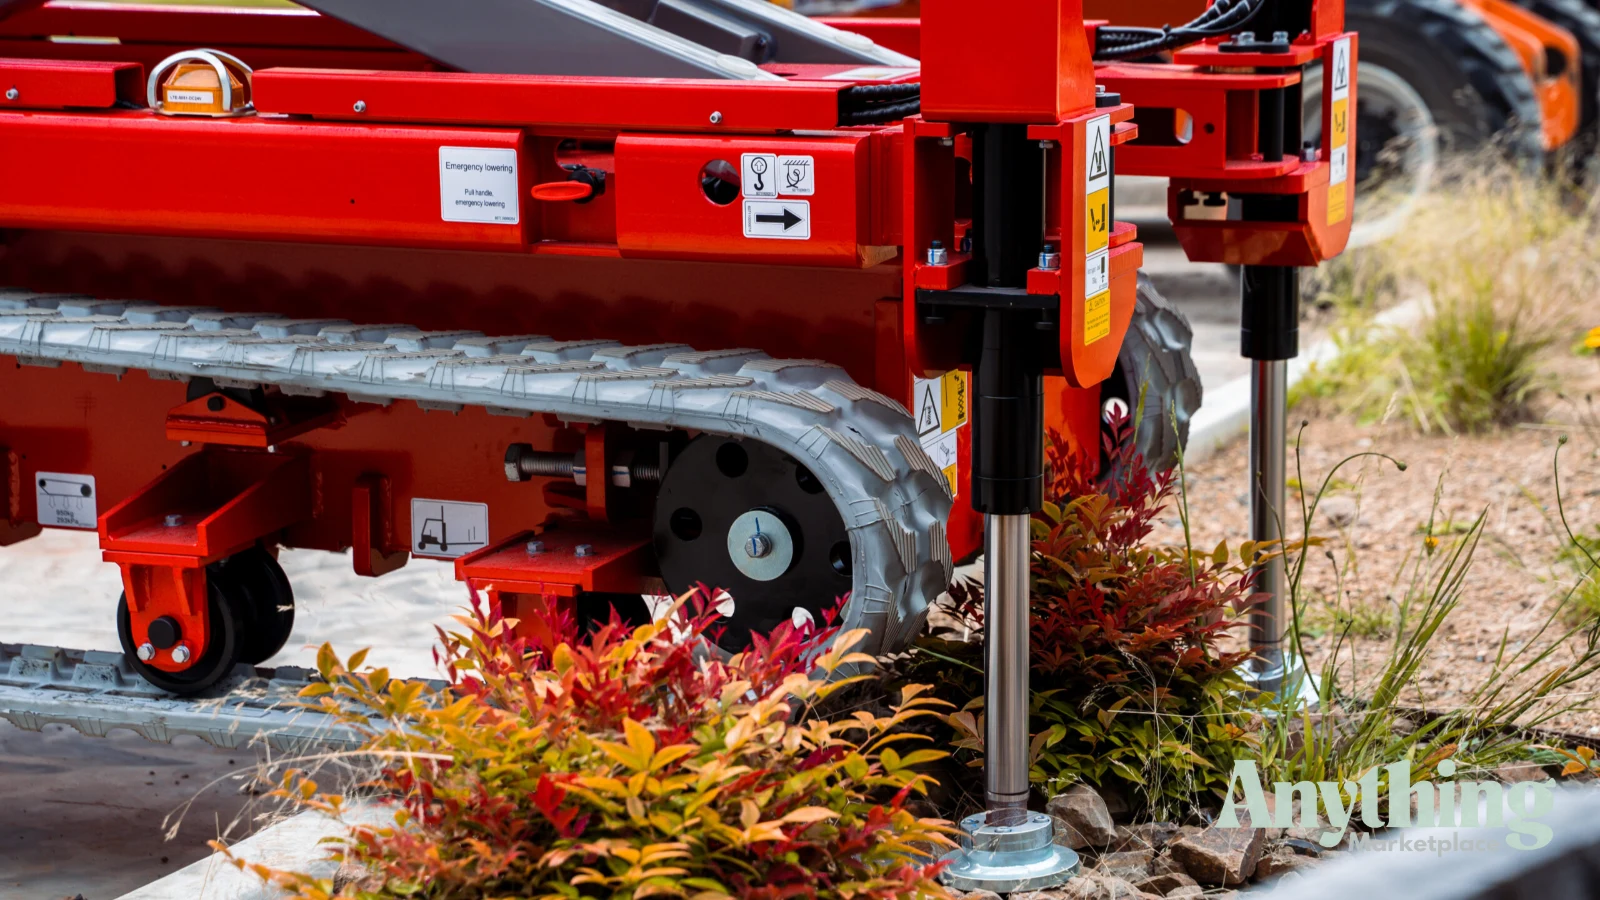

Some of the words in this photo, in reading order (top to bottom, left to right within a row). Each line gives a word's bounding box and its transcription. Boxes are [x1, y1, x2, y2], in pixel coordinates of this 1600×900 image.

[445, 161, 484, 172] Emergency
[484, 163, 513, 174] lowering
[464, 188, 475, 196] Pull
[475, 189, 494, 197] handle,
[483, 200, 505, 209] lowering
